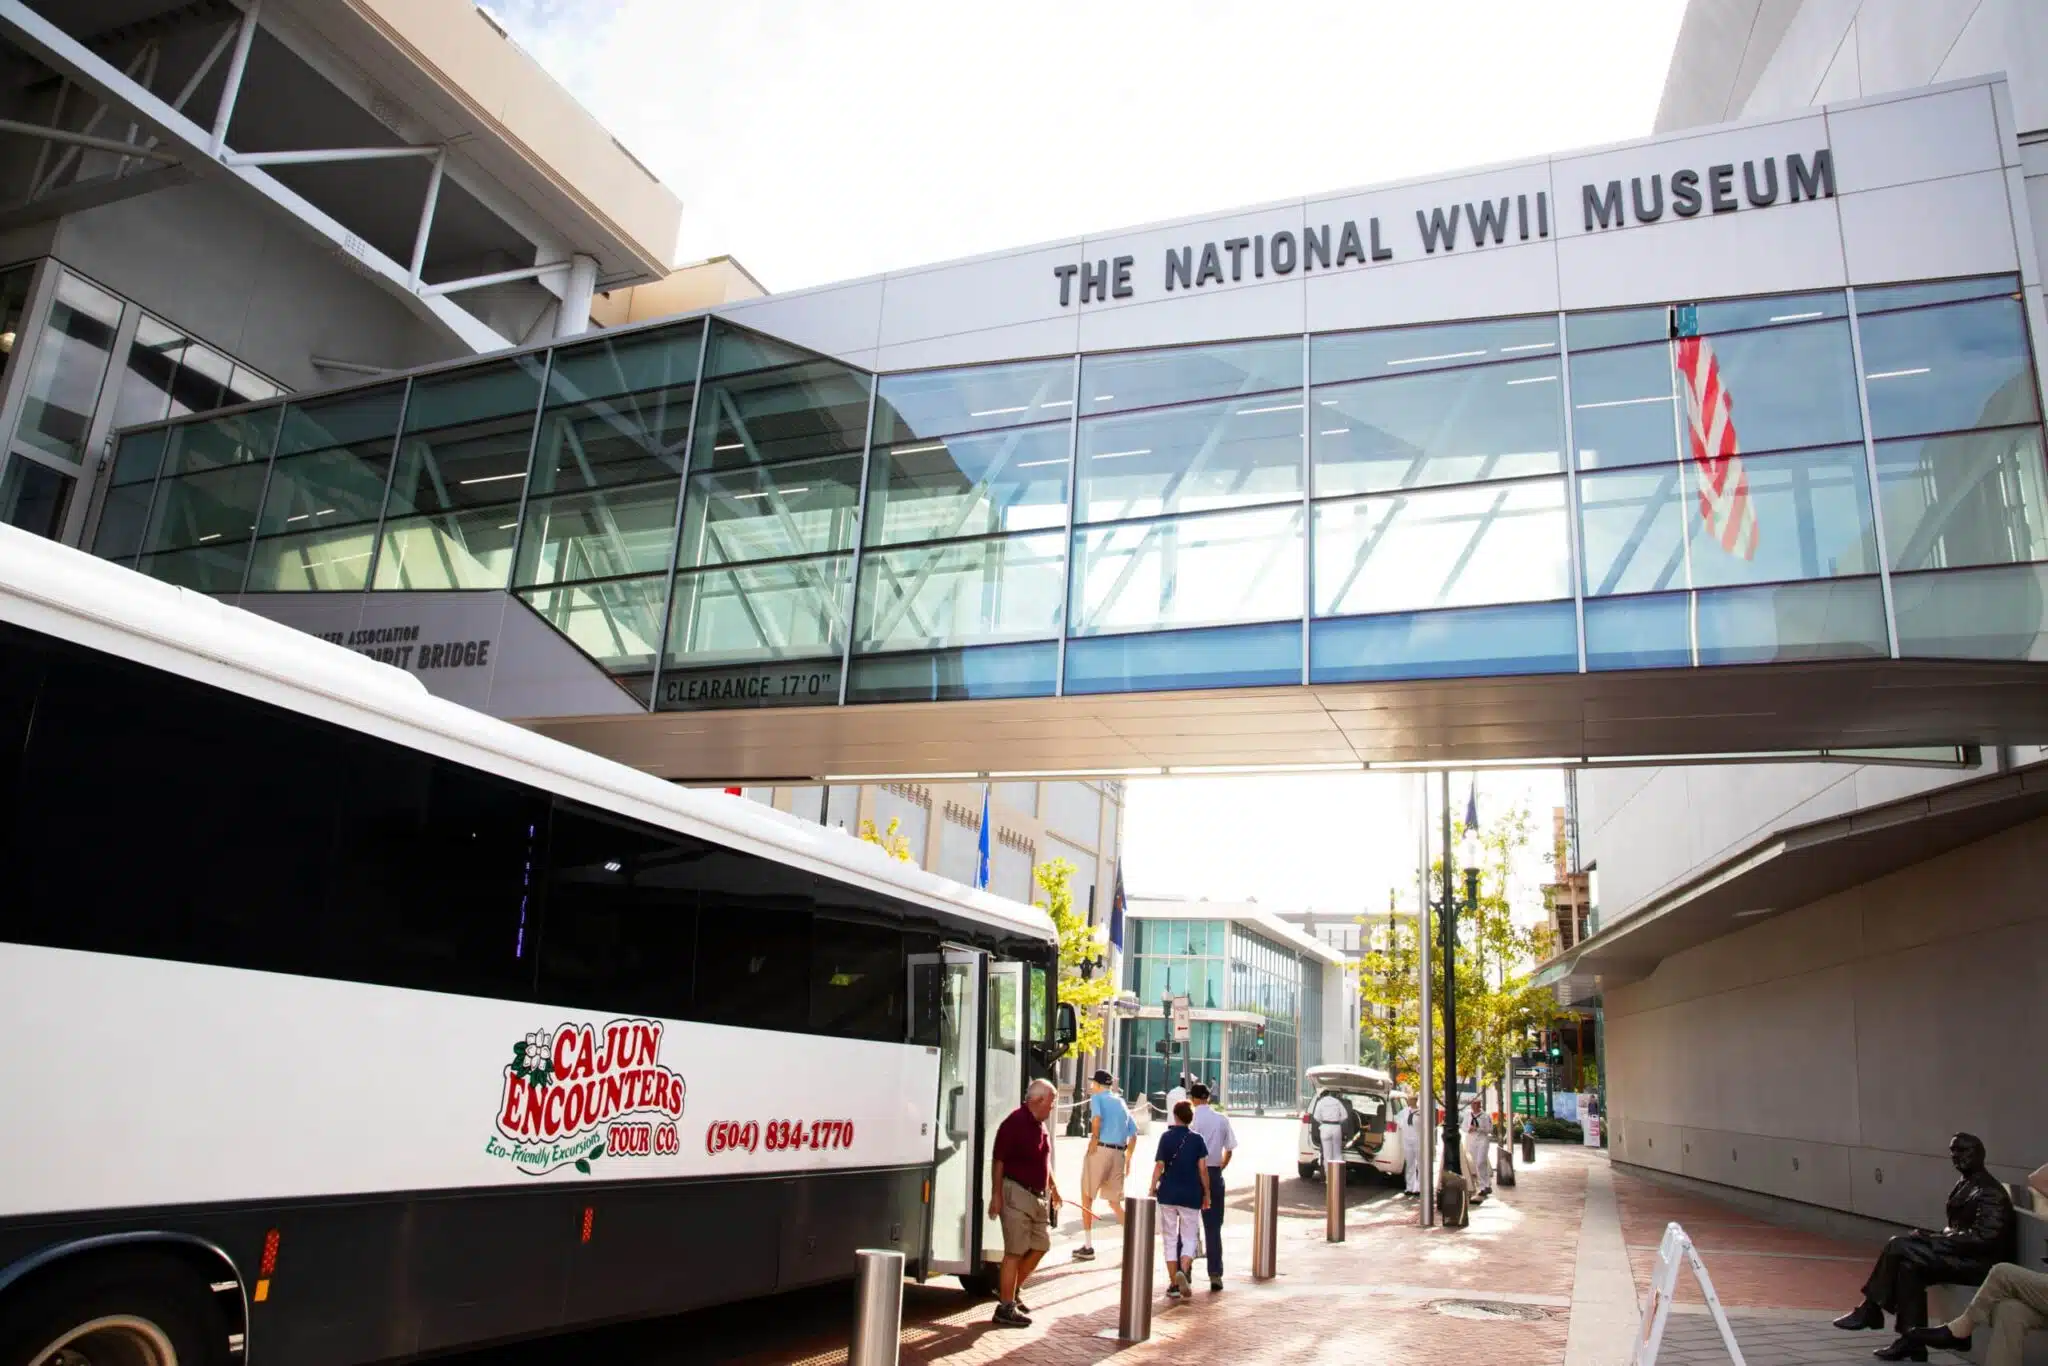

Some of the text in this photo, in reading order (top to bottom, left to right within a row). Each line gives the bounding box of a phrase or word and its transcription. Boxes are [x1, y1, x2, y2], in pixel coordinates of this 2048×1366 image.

[1054, 148, 1836, 307] THE NATIONAL WWII MUSEUM
[348, 625, 420, 646] ASSOCIATION
[417, 639, 491, 670] BRIDGE
[666, 676, 771, 702] CLEARANCE
[553, 1024, 661, 1081] CAJUN
[502, 1069, 684, 1137] ENCOUNTERS
[485, 1131, 601, 1168] Eco-Friendly Excursions
[607, 1125, 679, 1153] TOUR CO.
[705, 1118, 854, 1155] (504) 834-1770
